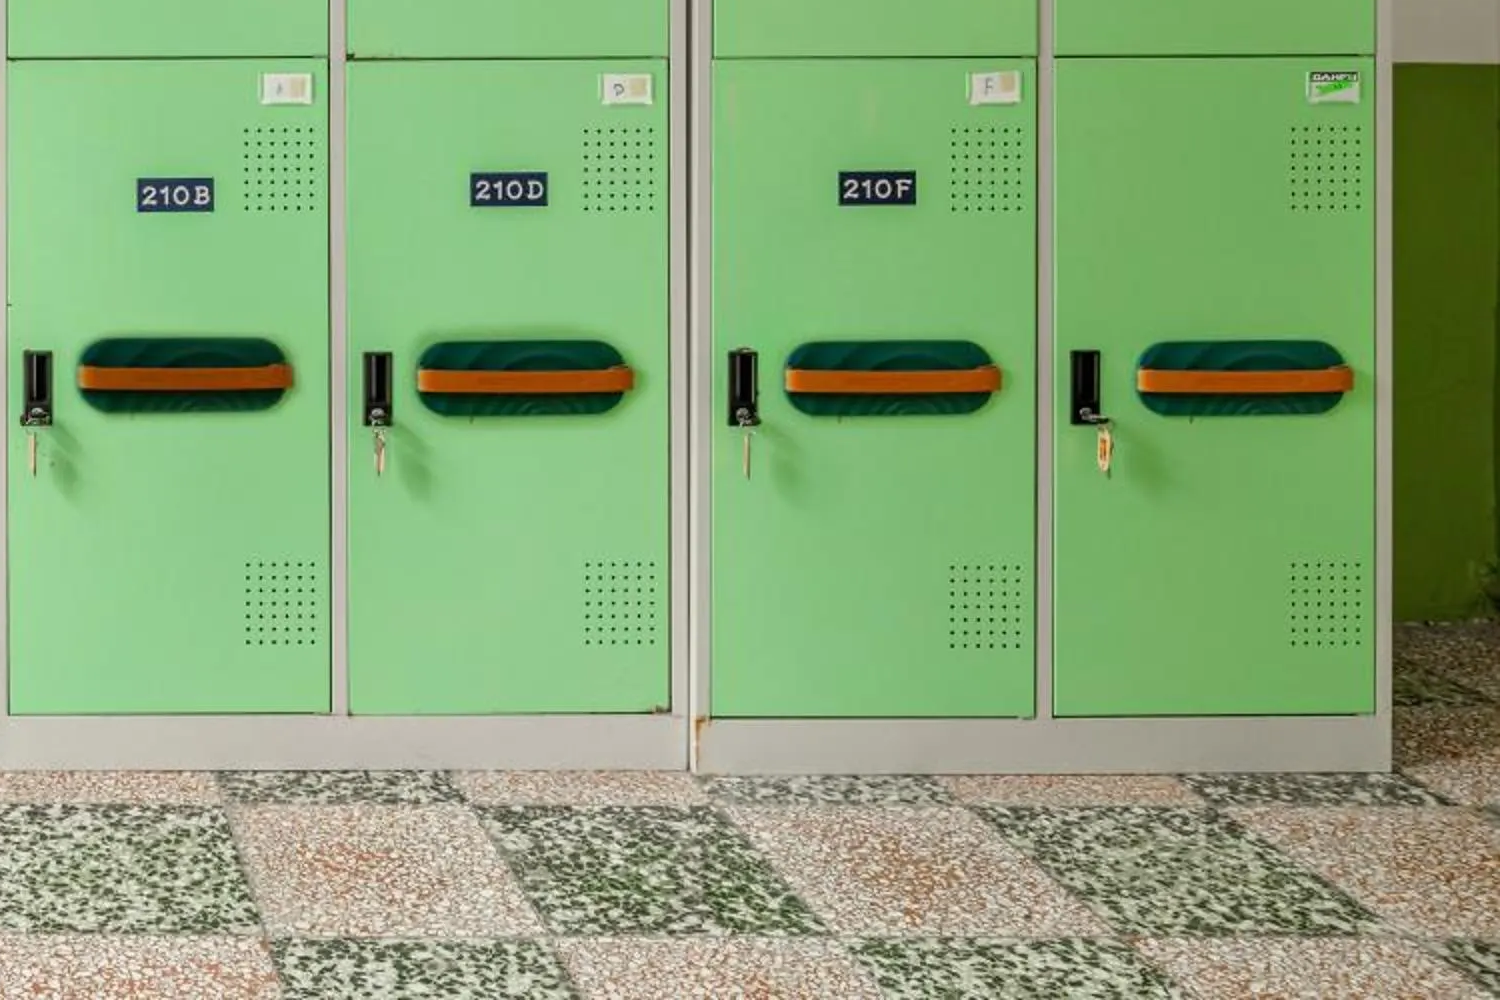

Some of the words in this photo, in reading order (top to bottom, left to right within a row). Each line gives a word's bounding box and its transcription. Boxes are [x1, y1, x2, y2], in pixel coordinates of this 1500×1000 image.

[141, 185, 211, 206] 210B
[475, 180, 544, 200] 210D
[843, 179, 912, 199] 210F
